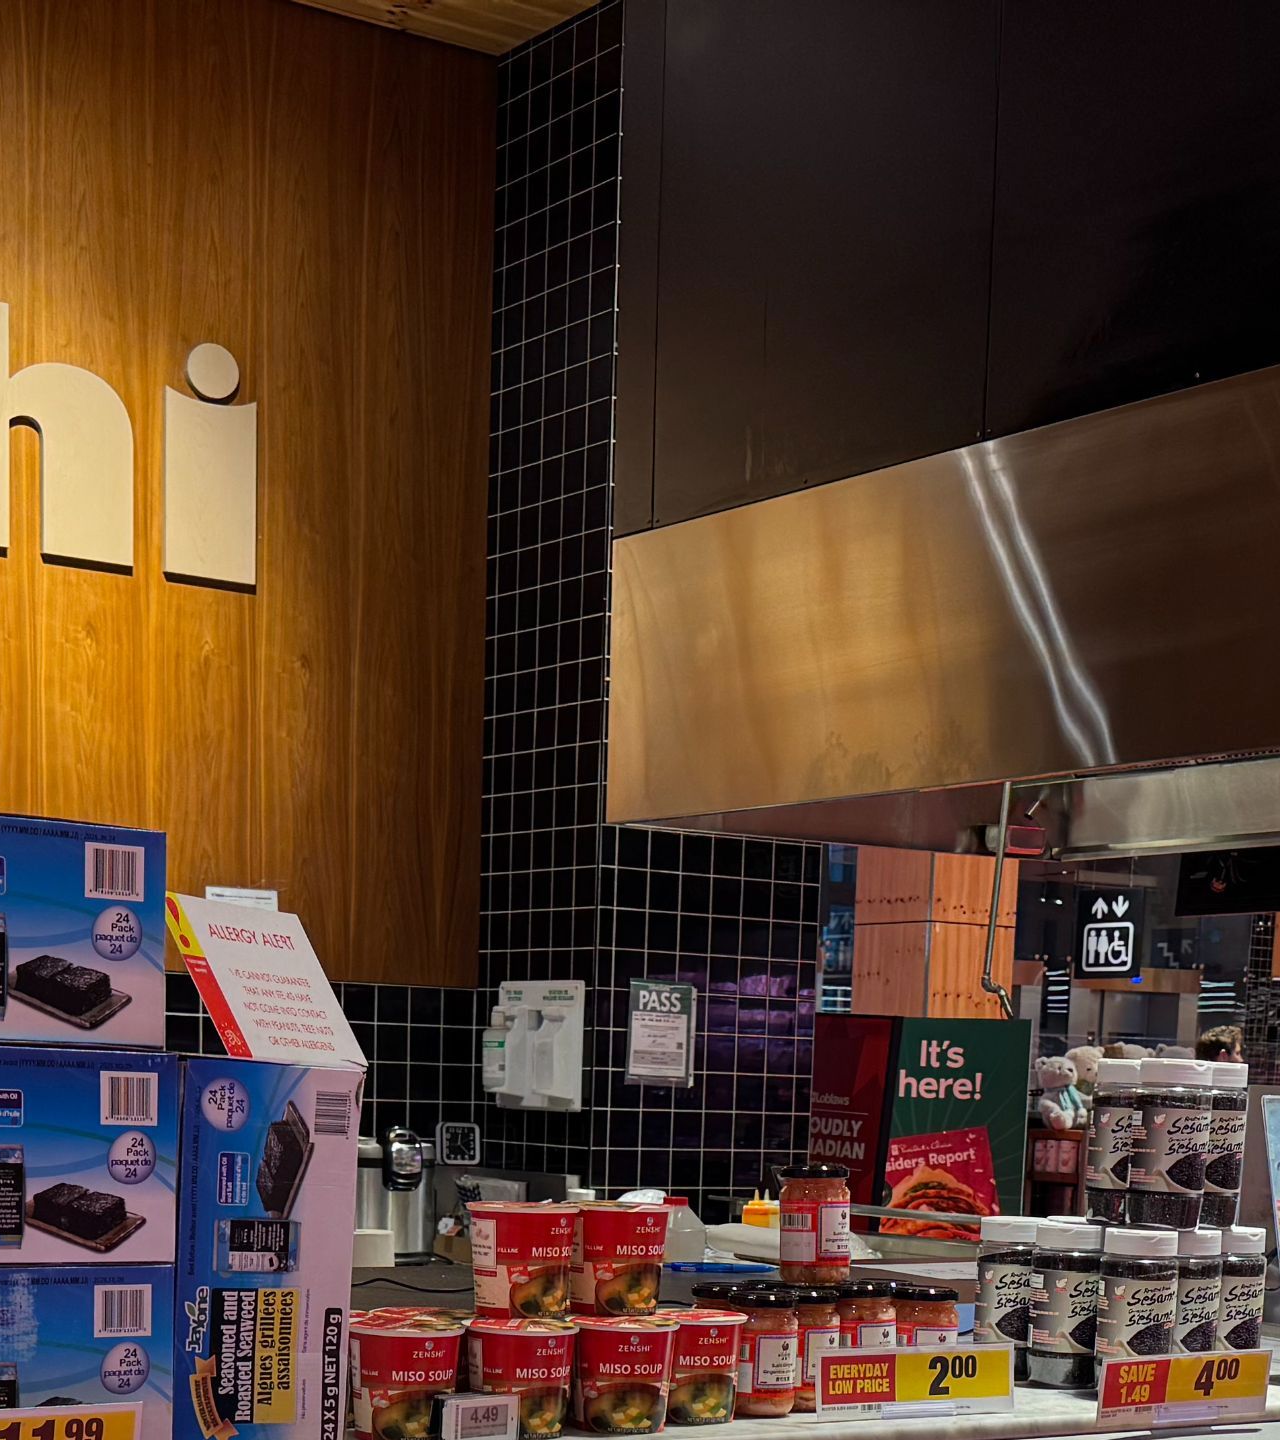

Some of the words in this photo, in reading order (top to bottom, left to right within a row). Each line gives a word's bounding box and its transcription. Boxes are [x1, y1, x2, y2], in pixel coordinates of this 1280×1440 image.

[115, 912, 129, 924] 24
[110, 923, 134, 934] Pack
[95, 933, 124, 944] paquet
[208, 923, 258, 945] ALLERGY
[262, 932, 295, 950] ALERT
[110, 944, 123, 954] 24
[639, 990, 681, 1012] PASS
[898, 1069, 982, 1100] here!
[810, 1117, 863, 1137] OUDLY
[886, 1156, 924, 1171] siders
[929, 1150, 975, 1167] Report
[329, 1314, 342, 1323] g
[326, 1325, 338, 1351] 120
[413, 1350, 445, 1359] ZENSHI
[325, 1356, 336, 1384] NET
[392, 1370, 426, 1382] MISO
[428, 1369, 453, 1381] SOUP
[599, 1363, 631, 1375] MISO
[634, 1363, 663, 1375] SOUP
[829, 1363, 888, 1379] EVERYDAY
[1119, 1363, 1155, 1385] SAVE
[327, 1387, 338, 1396] g
[829, 1381, 853, 1395] LOW
[856, 1378, 889, 1394] PRICE
[1120, 1384, 1150, 1404] 1.49
[325, 1399, 335, 1407] 5
[324, 1410, 335, 1421] X
[470, 1407, 499, 1423] 4.49
[324, 1425, 334, 1440] 24
